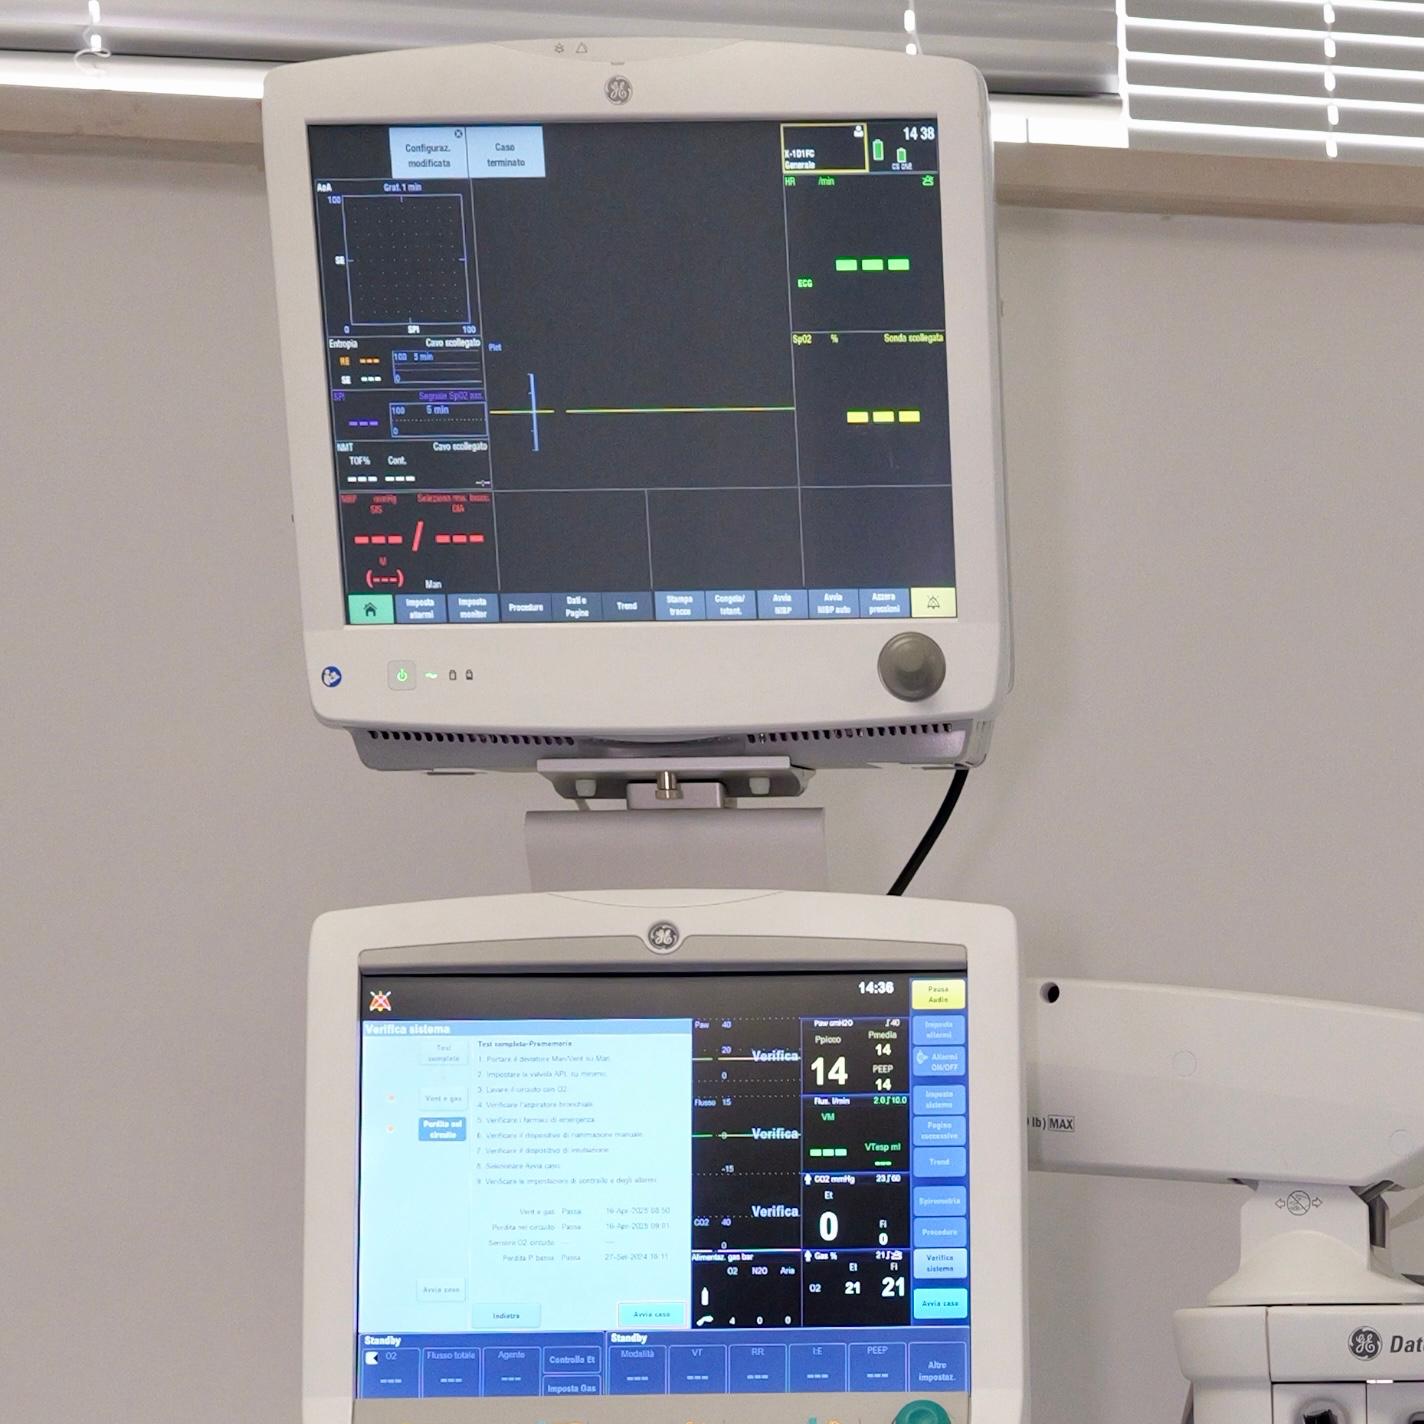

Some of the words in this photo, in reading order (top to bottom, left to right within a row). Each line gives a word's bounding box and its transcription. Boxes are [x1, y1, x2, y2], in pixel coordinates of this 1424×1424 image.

[405, 144, 451, 155] Configuraz.
[495, 143, 515, 152] Caso
[408, 158, 451, 168] modificata
[487, 158, 526, 167] terminato
[784, 176, 796, 186] HR
[797, 279, 813, 288] ECG
[462, 325, 477, 334] 100
[425, 338, 444, 348] Cavo
[792, 334, 812, 344] SpO2
[884, 333, 907, 343] Sonda
[908, 333, 945, 344] scollegata
[328, 339, 358, 349] Entropia
[392, 406, 406, 415] 100
[433, 406, 449, 414] min
[432, 442, 451, 451] Cavo
[617, 601, 638, 611] Trend
[858, 981, 895, 994] 14:36
[365, 1024, 408, 1035] Verifica
[409, 1024, 451, 1035] sistema
[721, 1021, 732, 1029] 40
[814, 1035, 842, 1045] Ppicco
[868, 1031, 898, 1040] Pmedia
[721, 1046, 732, 1054] 20
[875, 1043, 892, 1056] 14
[752, 1050, 800, 1062] Verifica
[810, 1056, 849, 1086] 14
[872, 1065, 894, 1073] PEEP
[721, 1071, 728, 1080] 0
[875, 1078, 892, 1091] 14
[694, 1098, 717, 1107] Flusso
[721, 1098, 732, 1106] 15
[821, 1113, 835, 1121] VM
[1049, 1117, 1073, 1130] MAX
[752, 1127, 800, 1140] Verifica
[864, 1143, 889, 1153] VTesp
[824, 1191, 834, 1200] Et
[752, 1205, 799, 1218] Verifica
[693, 1218, 710, 1227] CO2
[721, 1218, 732, 1226] 40
[819, 1211, 839, 1242] 0
[878, 1232, 889, 1246] 0
[721, 1241, 728, 1249] 0
[926, 1254, 954, 1262] Verifica
[727, 1267, 738, 1276] O2
[751, 1266, 769, 1275] N2O
[779, 1266, 795, 1275] Aria
[849, 1263, 858, 1272] Et
[926, 1265, 954, 1273] sistema
[809, 1284, 822, 1293] O2
[844, 1281, 861, 1295] 21
[881, 1276, 905, 1297] 21
[921, 1300, 941, 1308] Avvia
[943, 1300, 959, 1308] caso
[729, 1316, 736, 1325] 4
[756, 1316, 764, 1325] 0
[784, 1316, 792, 1325] 0
[364, 1336, 402, 1348] Standby
[610, 1333, 648, 1345] Standby
[426, 1351, 453, 1360] Flusso
[454, 1351, 476, 1360] totale
[497, 1350, 526, 1361] Agente
[751, 1347, 765, 1357] RR
[866, 1346, 888, 1355] PEEP
[549, 1355, 585, 1365] Controllo
[927, 1361, 948, 1369] Altro
[918, 1373, 956, 1383] impostaz.
[547, 1384, 580, 1395] Imposta
[580, 1384, 597, 1394] Gas
